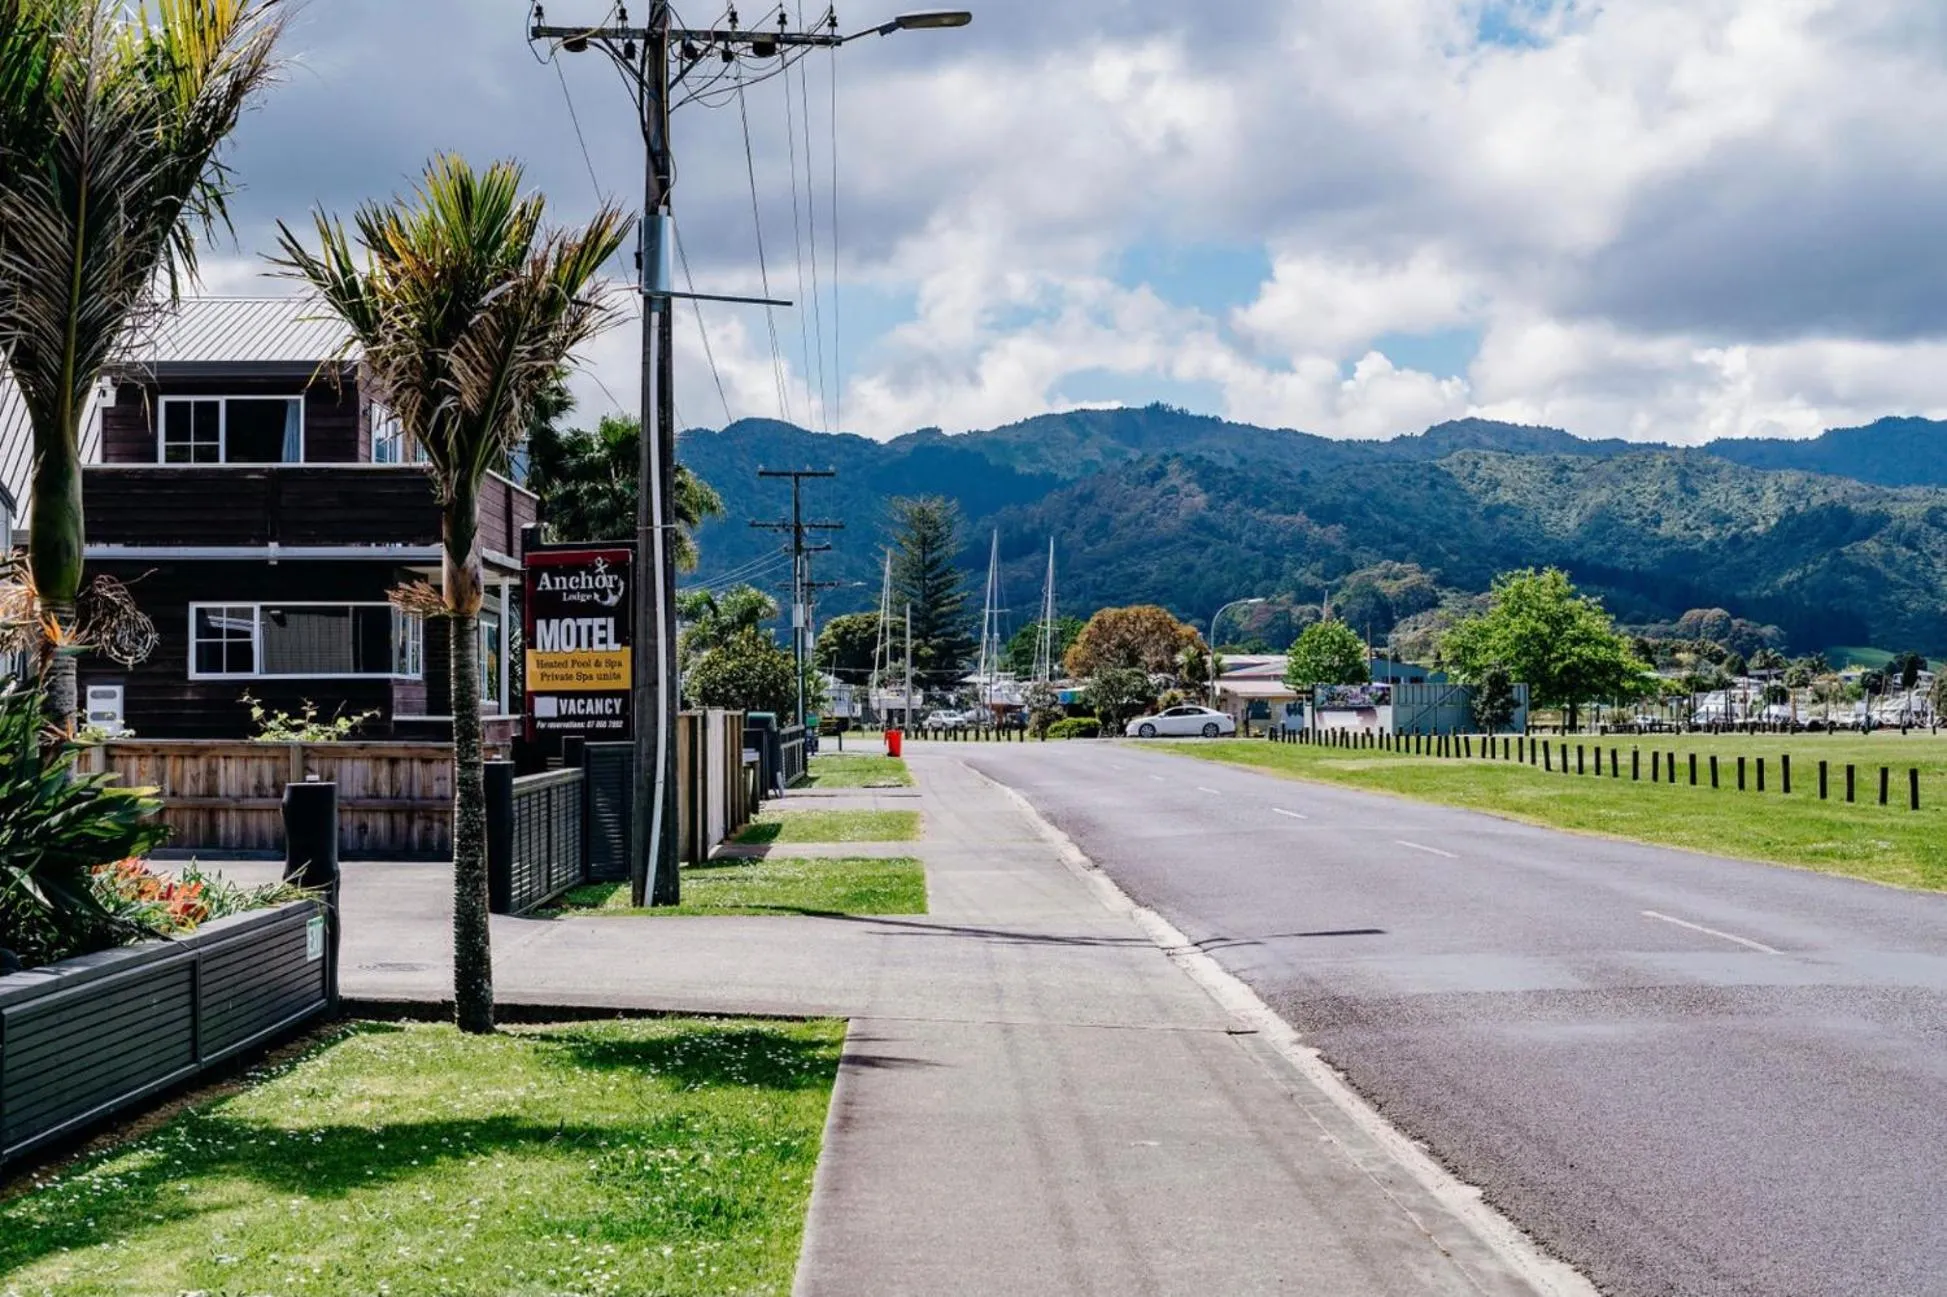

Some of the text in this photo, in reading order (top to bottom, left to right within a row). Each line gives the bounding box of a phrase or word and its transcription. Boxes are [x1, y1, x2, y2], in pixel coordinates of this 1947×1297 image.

[536, 571, 619, 591] Anchor
[562, 592, 593, 603] Lodge
[536, 617, 621, 653] MOTEL
[536, 659, 623, 669] Heated Pool & Spa
[540, 671, 622, 683] Private Spa units
[560, 698, 622, 715] VACANCY
